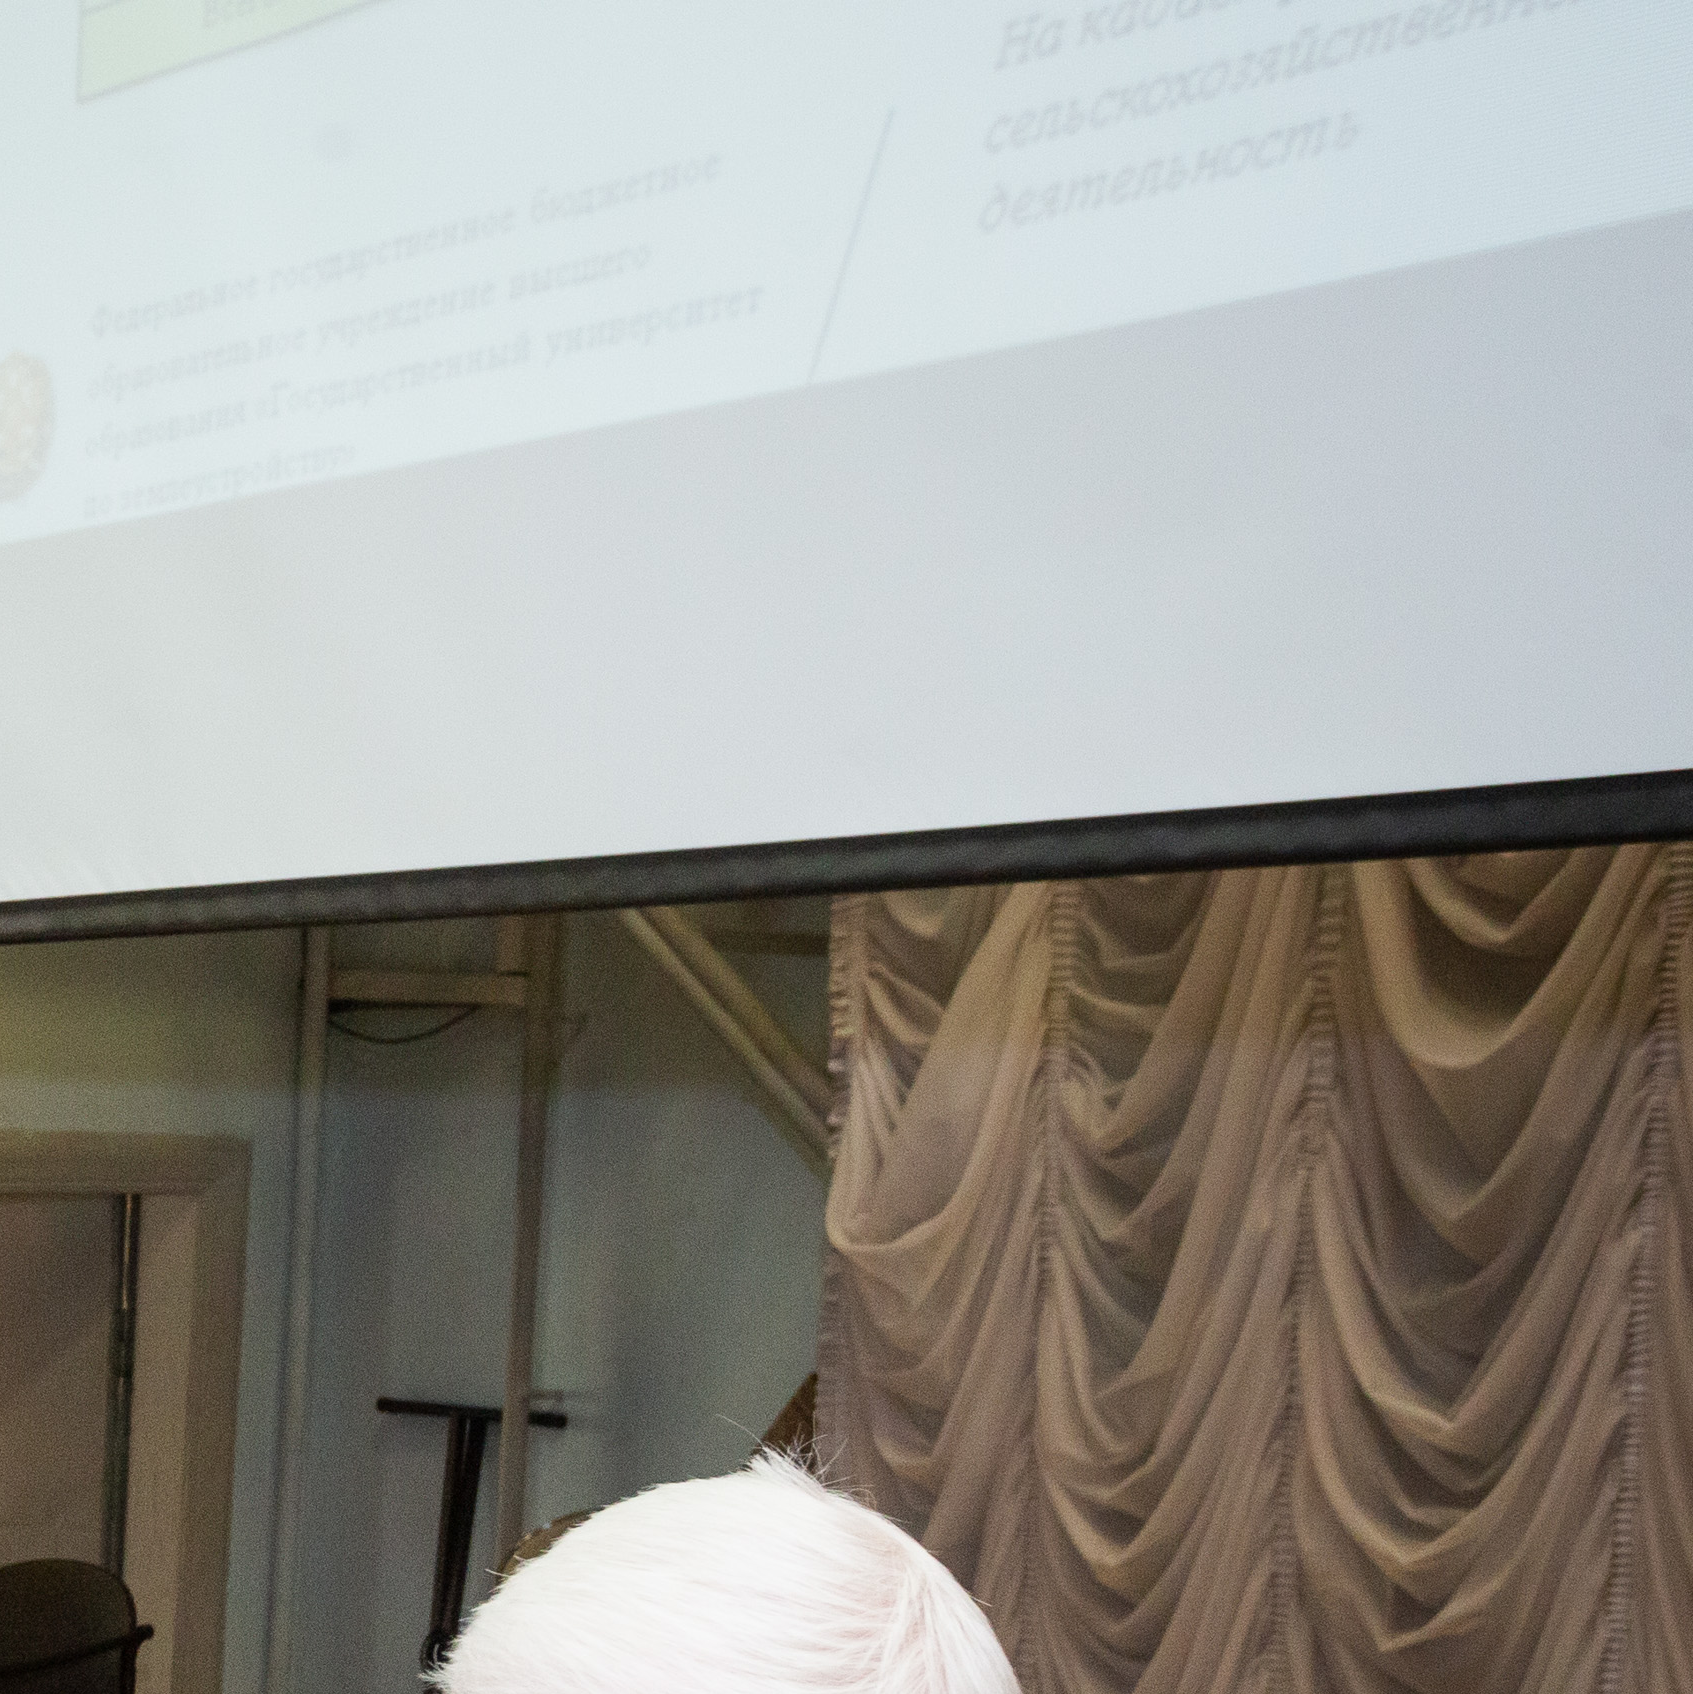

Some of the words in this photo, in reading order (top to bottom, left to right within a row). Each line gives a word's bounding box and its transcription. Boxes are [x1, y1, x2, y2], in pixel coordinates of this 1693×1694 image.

[993, 11, 1063, 70] На
[90, 276, 258, 339] Федеральное
[268, 207, 516, 296] государственное
[529, 152, 722, 225] бюджетное
[977, 111, 1363, 234] деятельность
[84, 400, 247, 462] образования
[545, 285, 765, 367] университет
[87, 328, 307, 404] образовательное
[317, 280, 495, 352] учреждение
[508, 244, 652, 301] высшего
